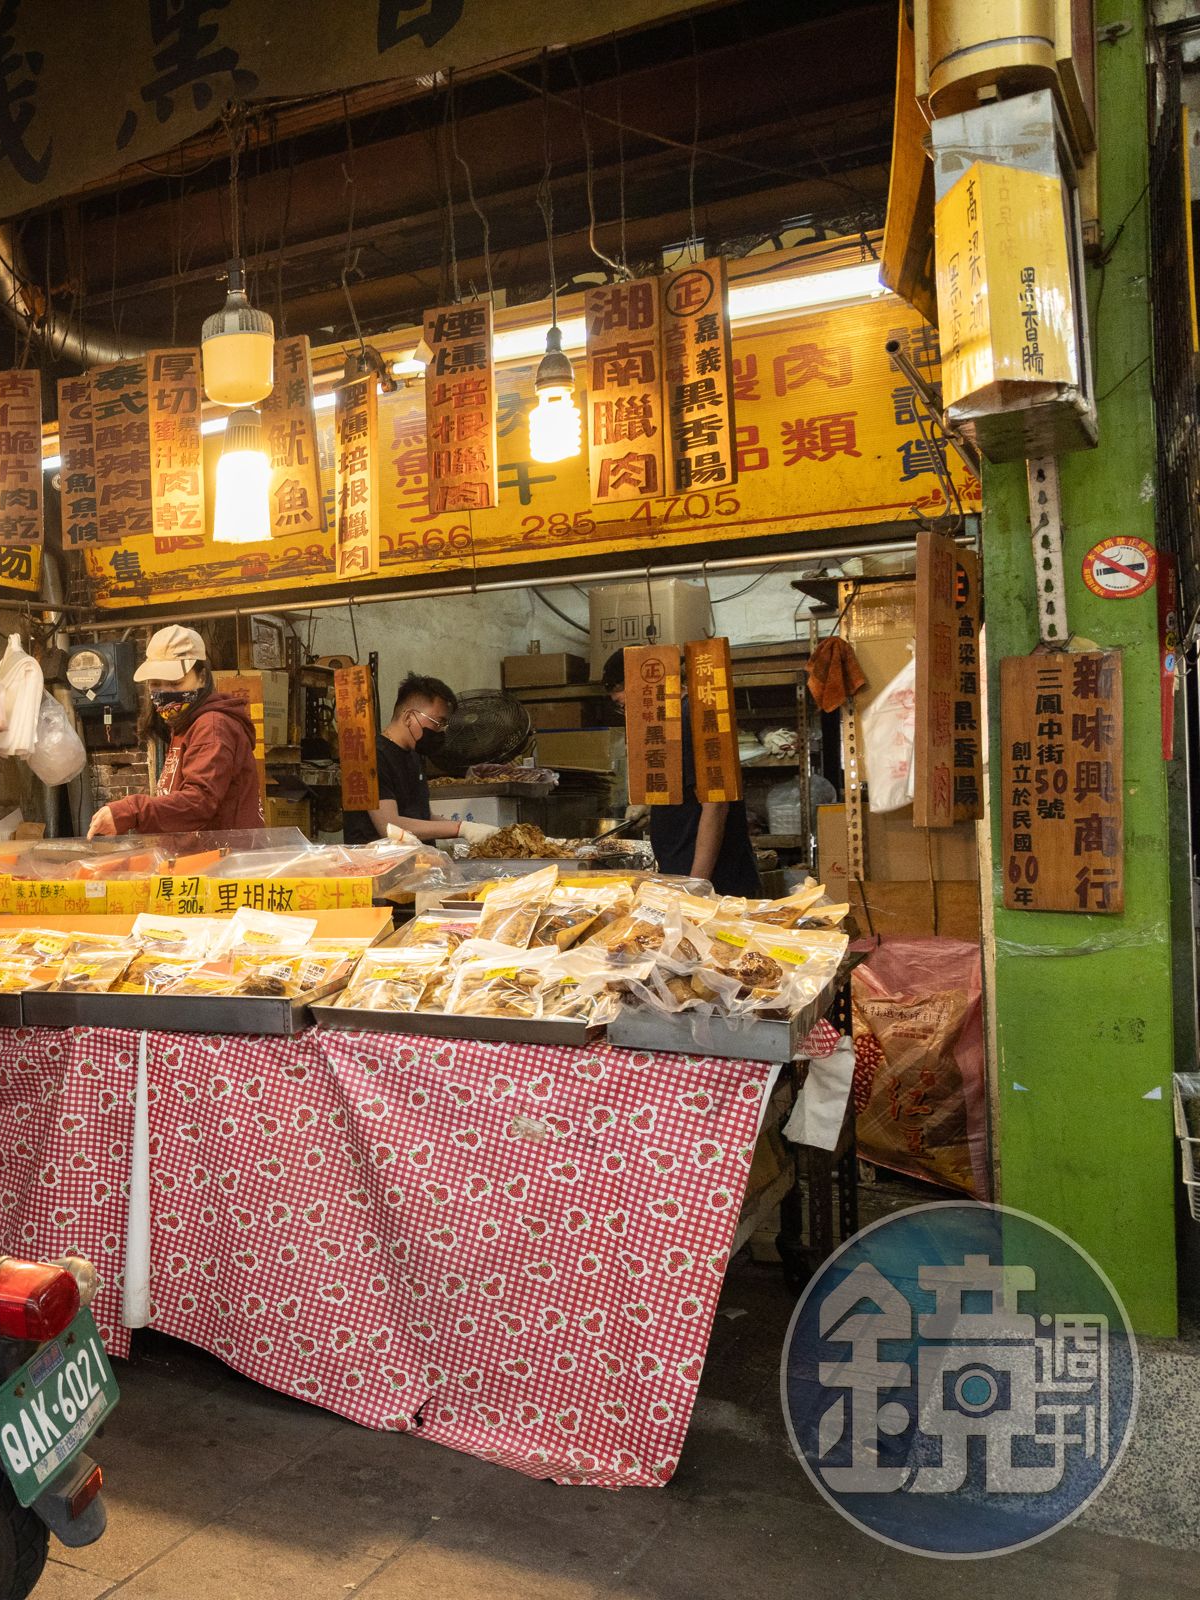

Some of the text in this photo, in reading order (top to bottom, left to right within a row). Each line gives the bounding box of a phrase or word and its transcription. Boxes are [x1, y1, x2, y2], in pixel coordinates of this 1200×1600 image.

[664, 323, 690, 382] 古早味
[693, 311, 722, 374] 嘉義
[1020, 267, 1044, 375] 黑香腸
[153, 353, 197, 414] 厚切
[428, 307, 490, 511] 煙燻培根臘肉
[590, 283, 658, 497] 湖南臘肉
[671, 377, 727, 489] 黑香腸
[774, 342, 862, 467] 肉類
[154, 420, 178, 469] 蜜汁
[178, 417, 200, 468] 黑胡椒
[268, 419, 314, 527] 魷魚
[337, 383, 370, 573] 煙燻培根臘肉
[156, 470, 202, 531] 肉乾
[644, 726, 668, 792] 黑香腸
[1035, 669, 1068, 819] 三鳳中街50號
[1071, 655, 1119, 909] 新味興商行
[1008, 741, 1039, 905] 創立於民國60年
[156, 877, 200, 901] 厚切
